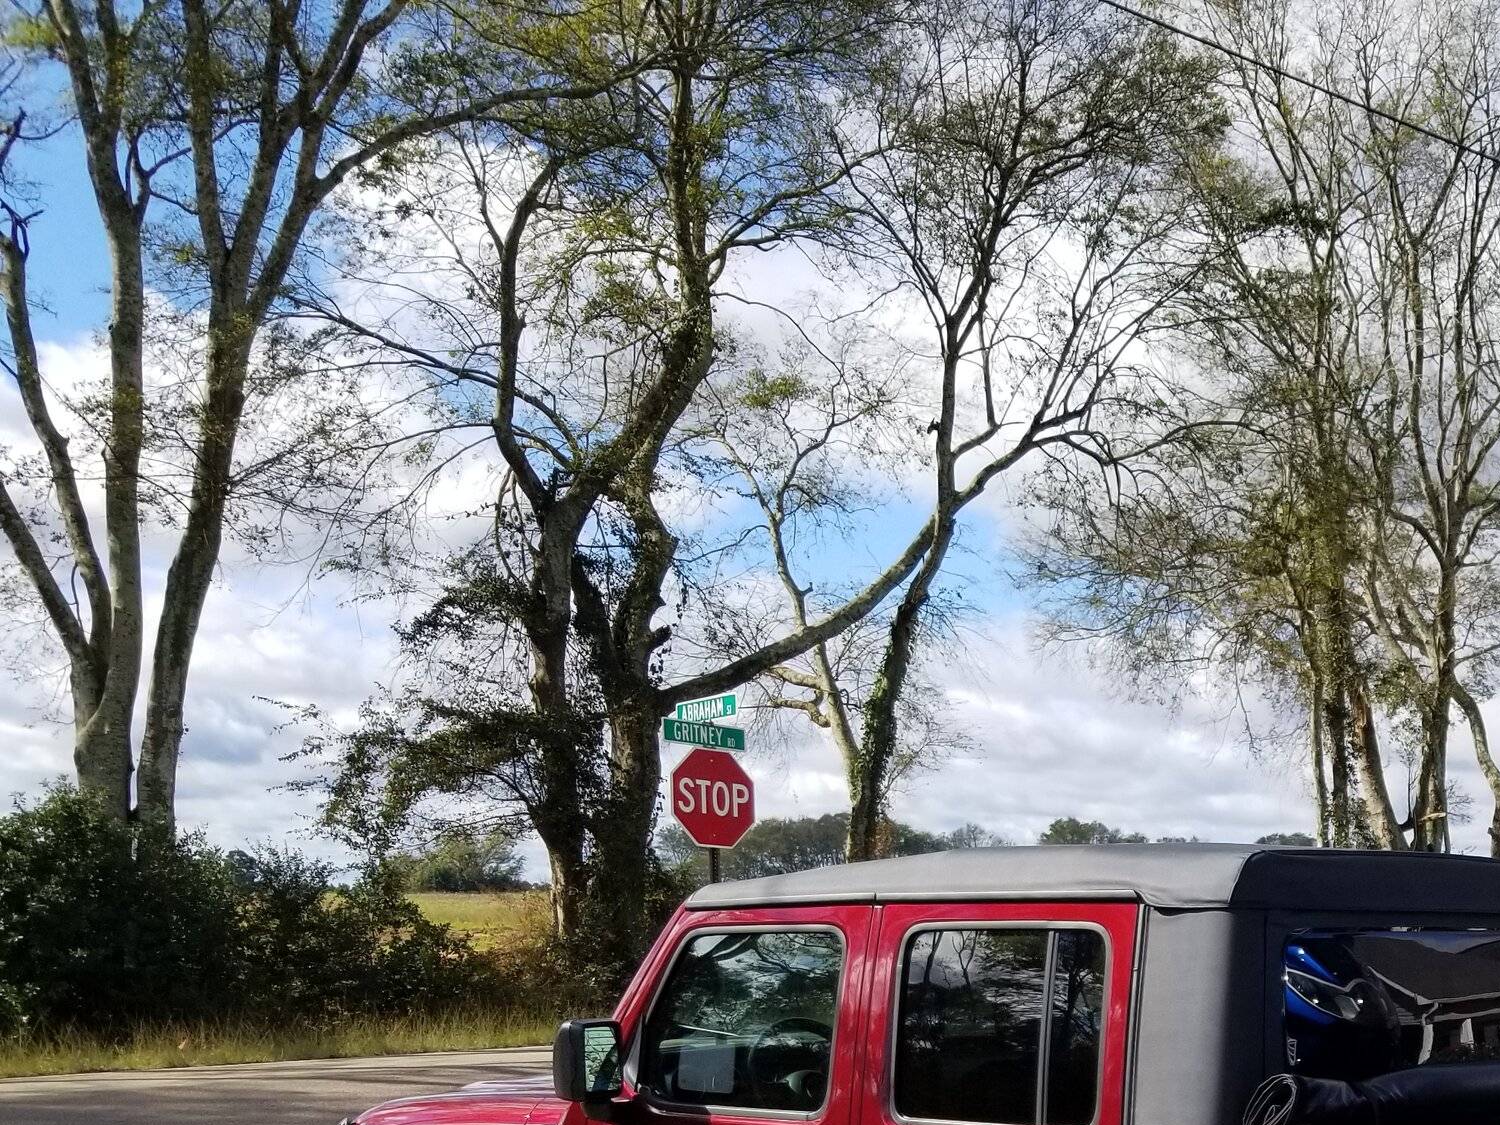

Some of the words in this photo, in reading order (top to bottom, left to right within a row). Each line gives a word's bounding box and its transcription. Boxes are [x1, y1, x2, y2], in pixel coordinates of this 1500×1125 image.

[682, 698, 724, 722] ABRAHAM
[726, 704, 733, 715] ST
[673, 722, 723, 747] GRITNEY
[727, 738, 736, 748] RD
[678, 777, 750, 818] STOP
